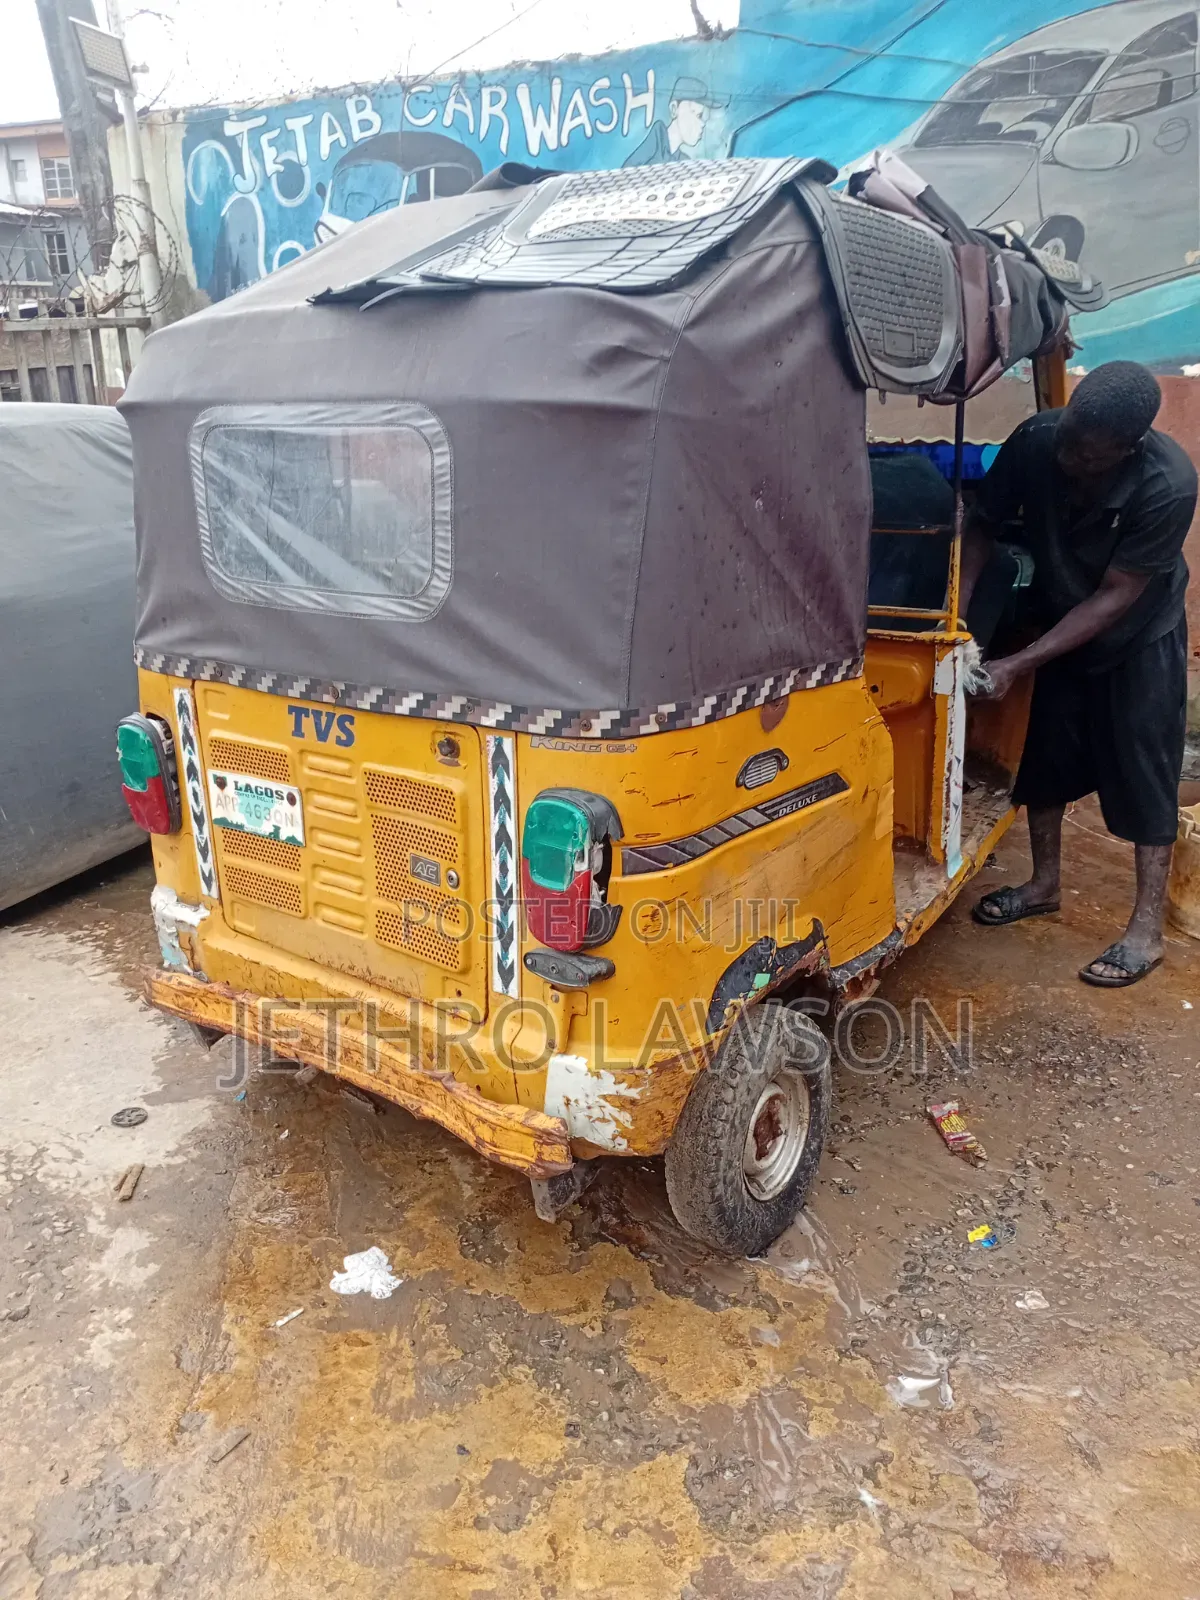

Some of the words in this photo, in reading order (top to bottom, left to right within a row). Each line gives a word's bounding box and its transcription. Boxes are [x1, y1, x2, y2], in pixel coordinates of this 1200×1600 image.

[223, 94, 382, 194] JETAB
[403, 83, 510, 157] CAR
[515, 68, 655, 157] WASH
[287, 704, 356, 748] TVS
[233, 780, 285, 801] LAGOS
[778, 793, 819, 818] DELUXE
